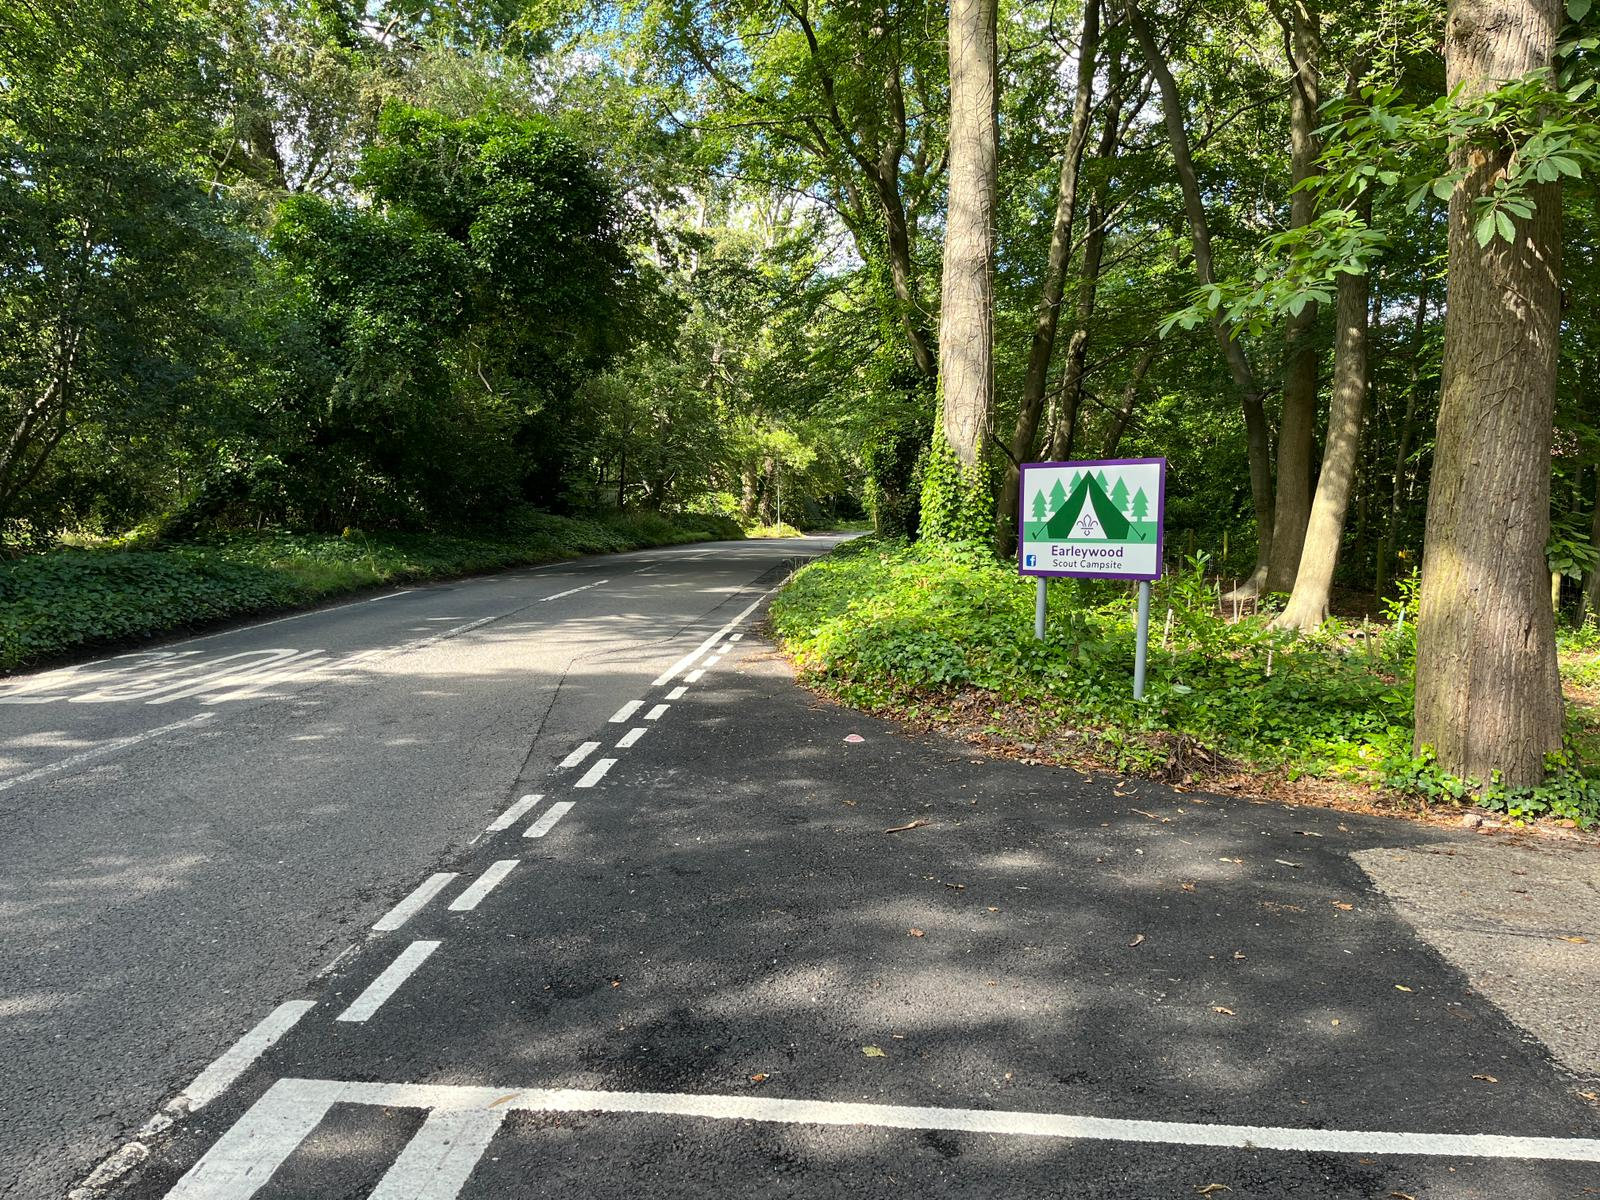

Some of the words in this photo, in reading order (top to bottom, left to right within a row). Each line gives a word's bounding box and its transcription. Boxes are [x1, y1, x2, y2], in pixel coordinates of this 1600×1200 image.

[1051, 545, 1124, 559] Earleywood
[1052, 559, 1077, 568] Scout
[1080, 560, 1122, 570] Campsite
